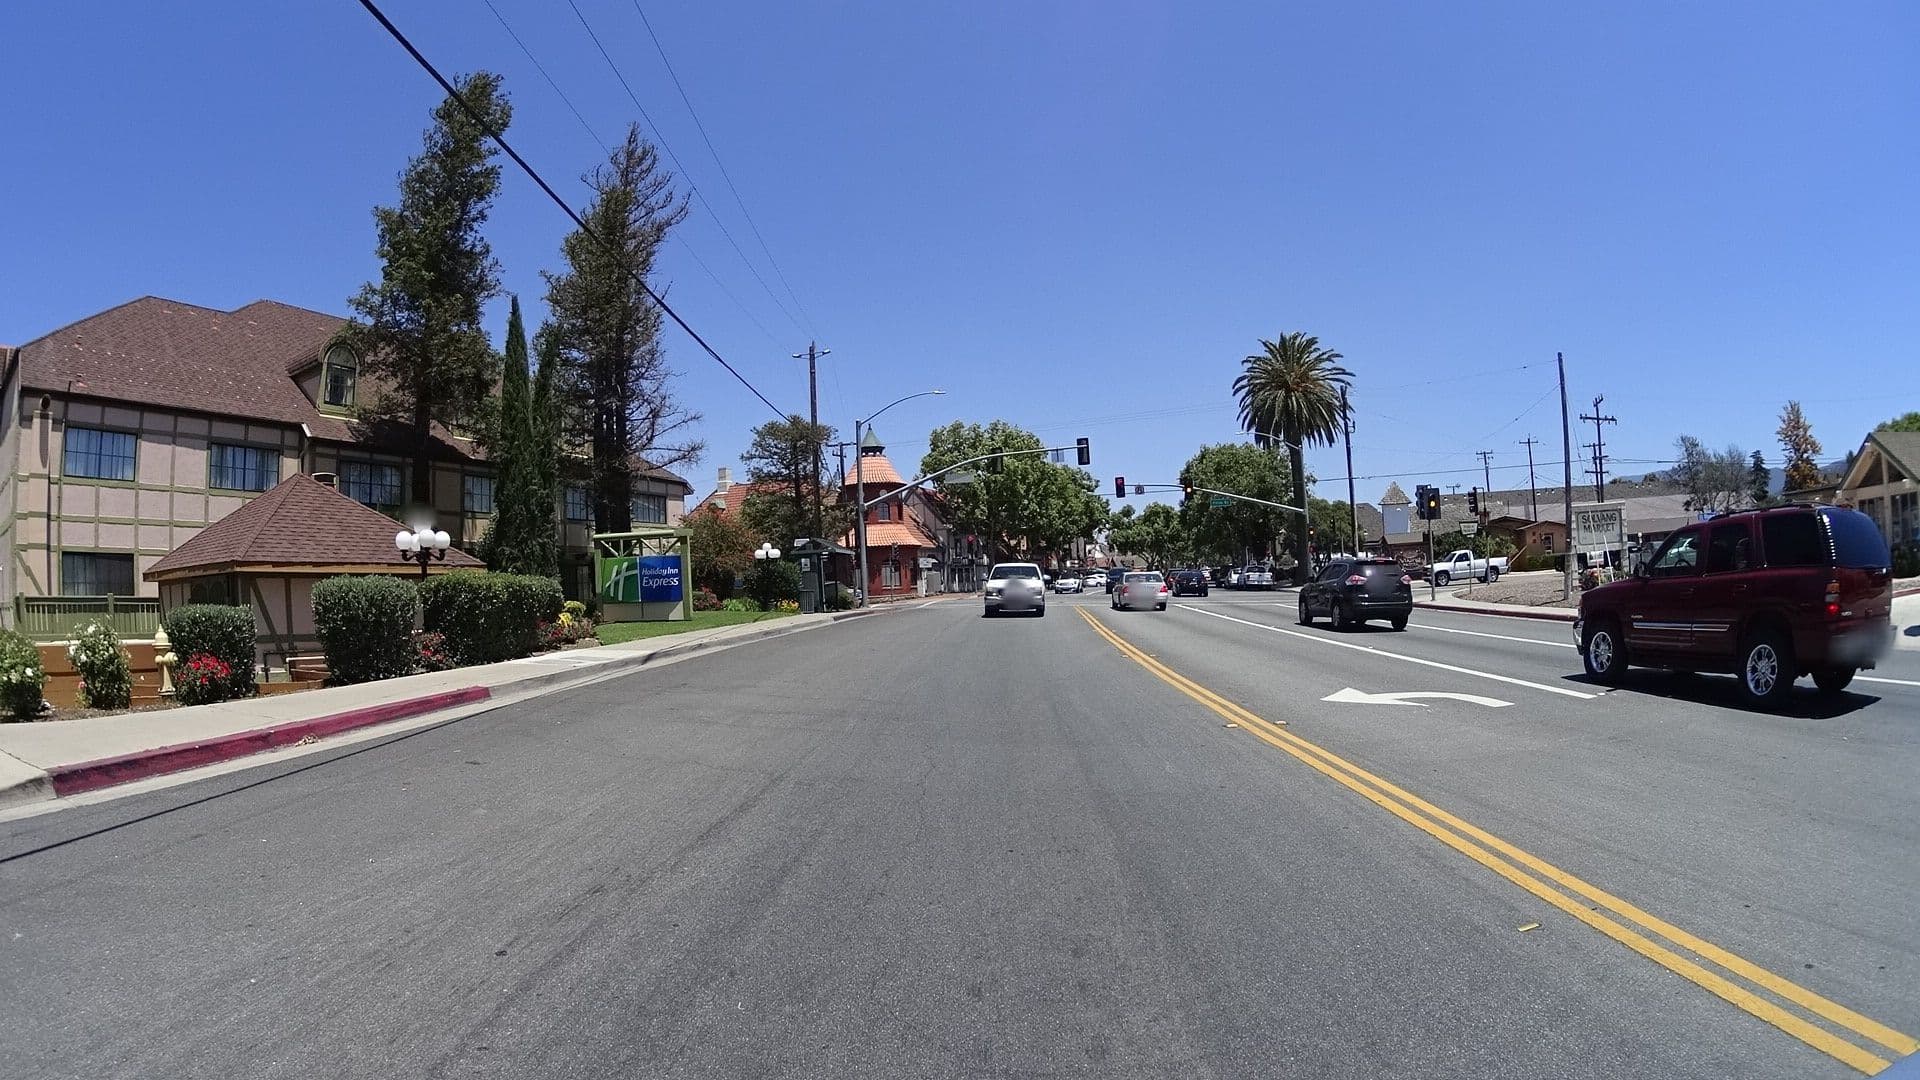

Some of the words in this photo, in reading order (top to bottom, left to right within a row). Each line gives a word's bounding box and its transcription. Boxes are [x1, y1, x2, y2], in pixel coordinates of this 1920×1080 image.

[1581, 512, 1617, 524] SOLVANG
[642, 567, 667, 577] Holiday
[667, 566, 679, 574] Inn
[642, 577, 679, 589] Express
